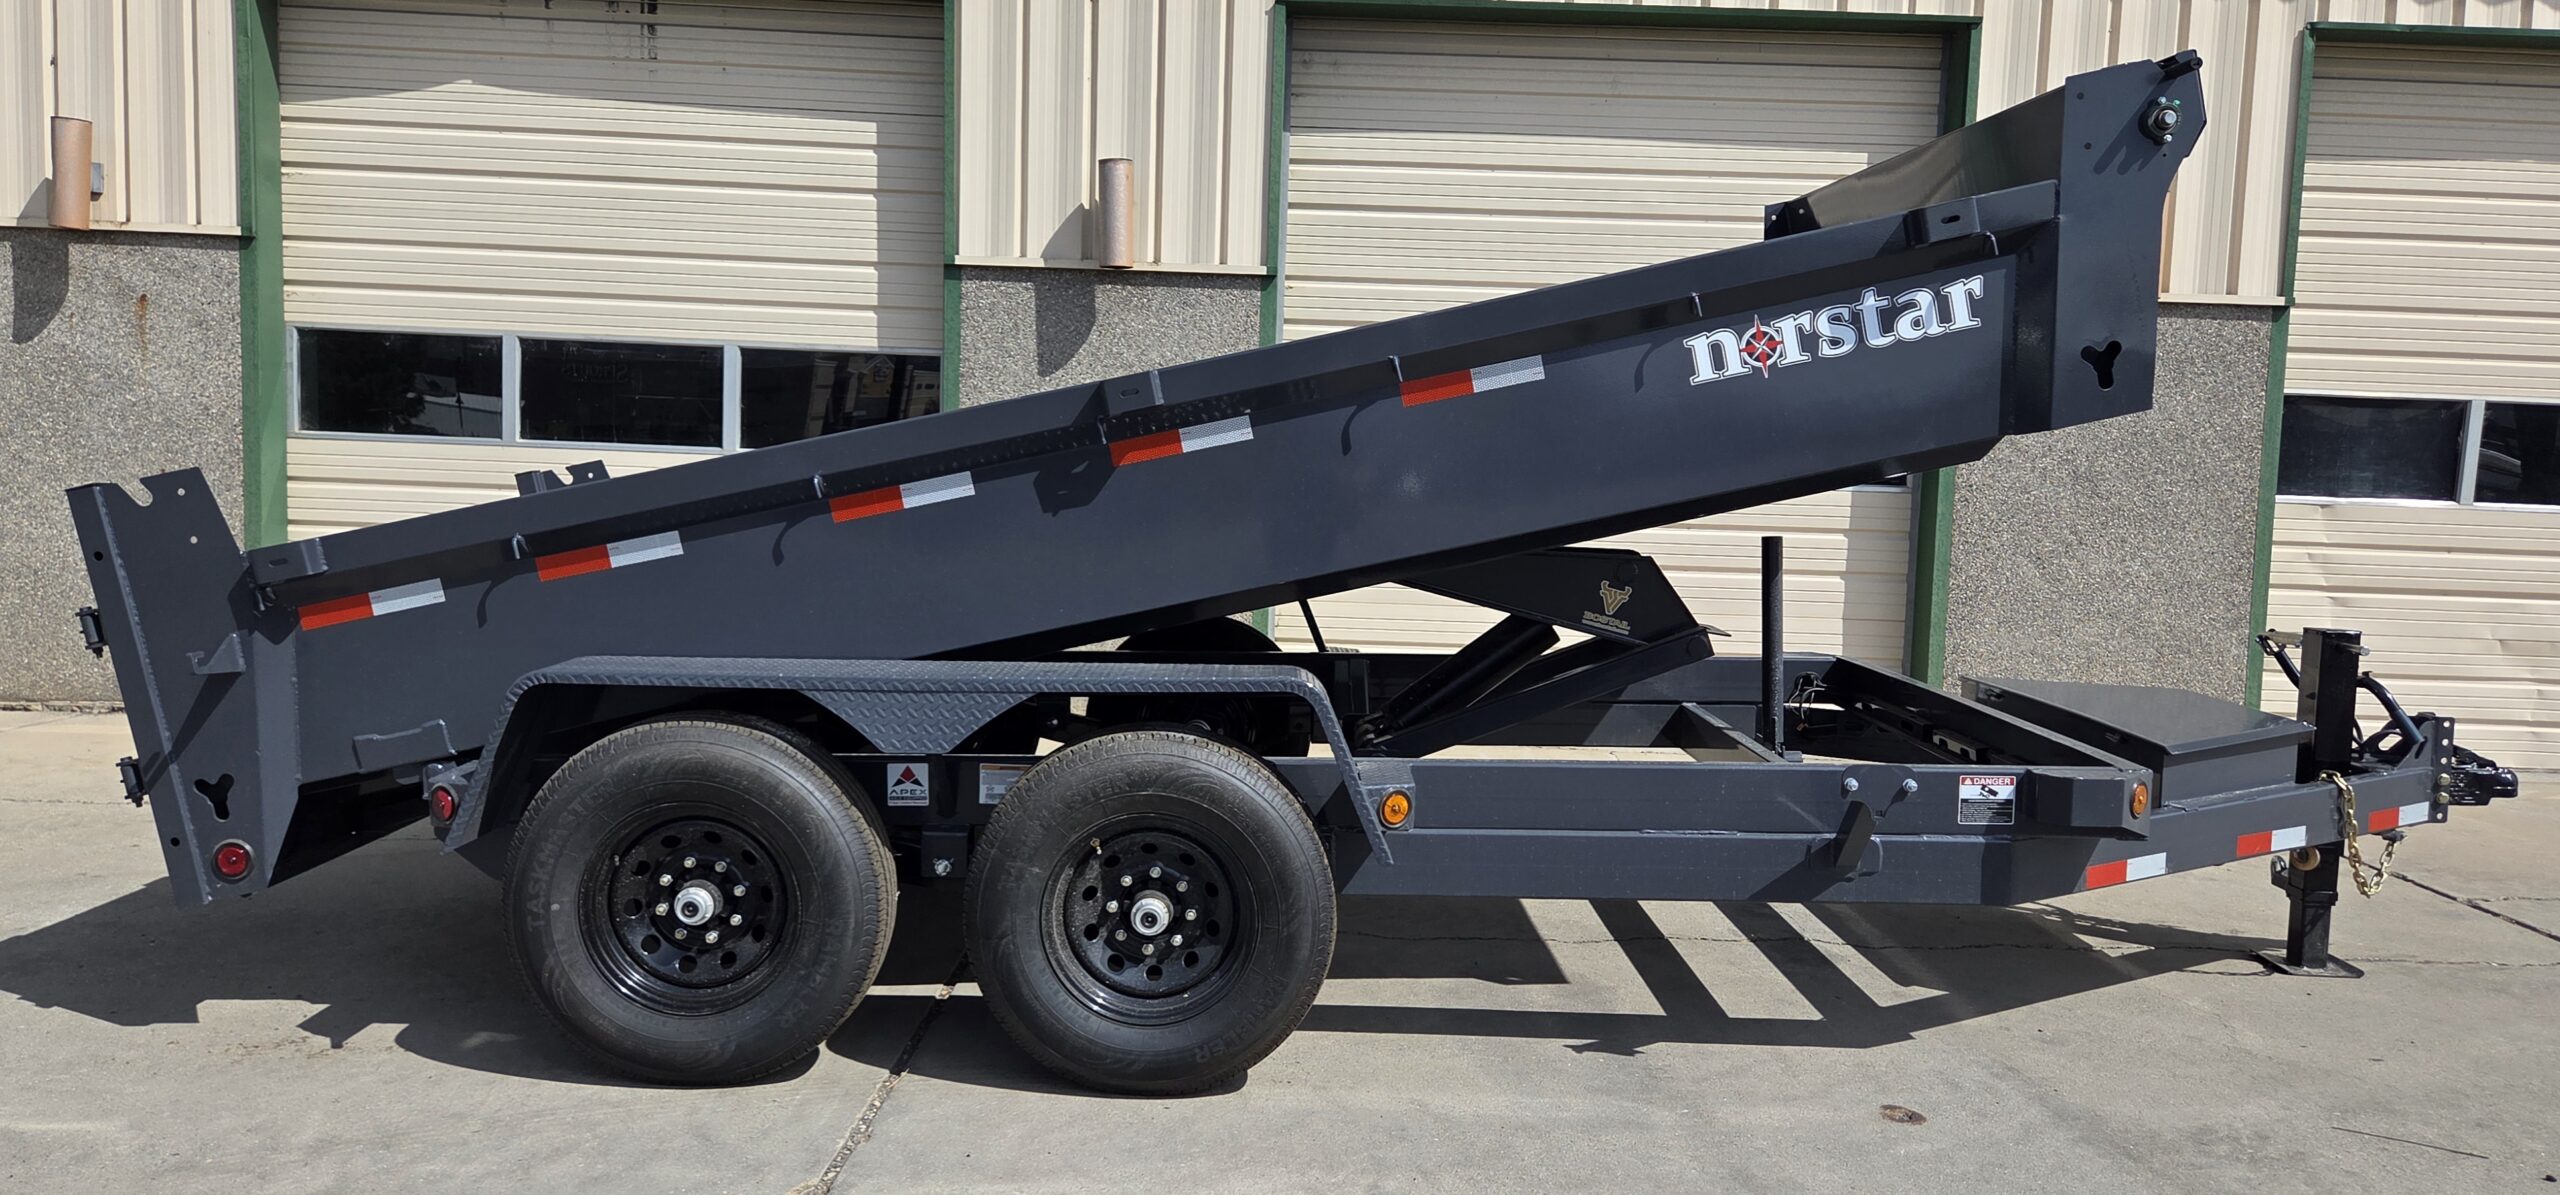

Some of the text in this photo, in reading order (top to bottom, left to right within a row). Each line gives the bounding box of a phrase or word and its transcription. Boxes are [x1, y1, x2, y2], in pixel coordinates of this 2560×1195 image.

[1683, 275, 1984, 386] norstar
[1973, 777, 2011, 785] DANGER
[889, 788, 928, 796] APEX
